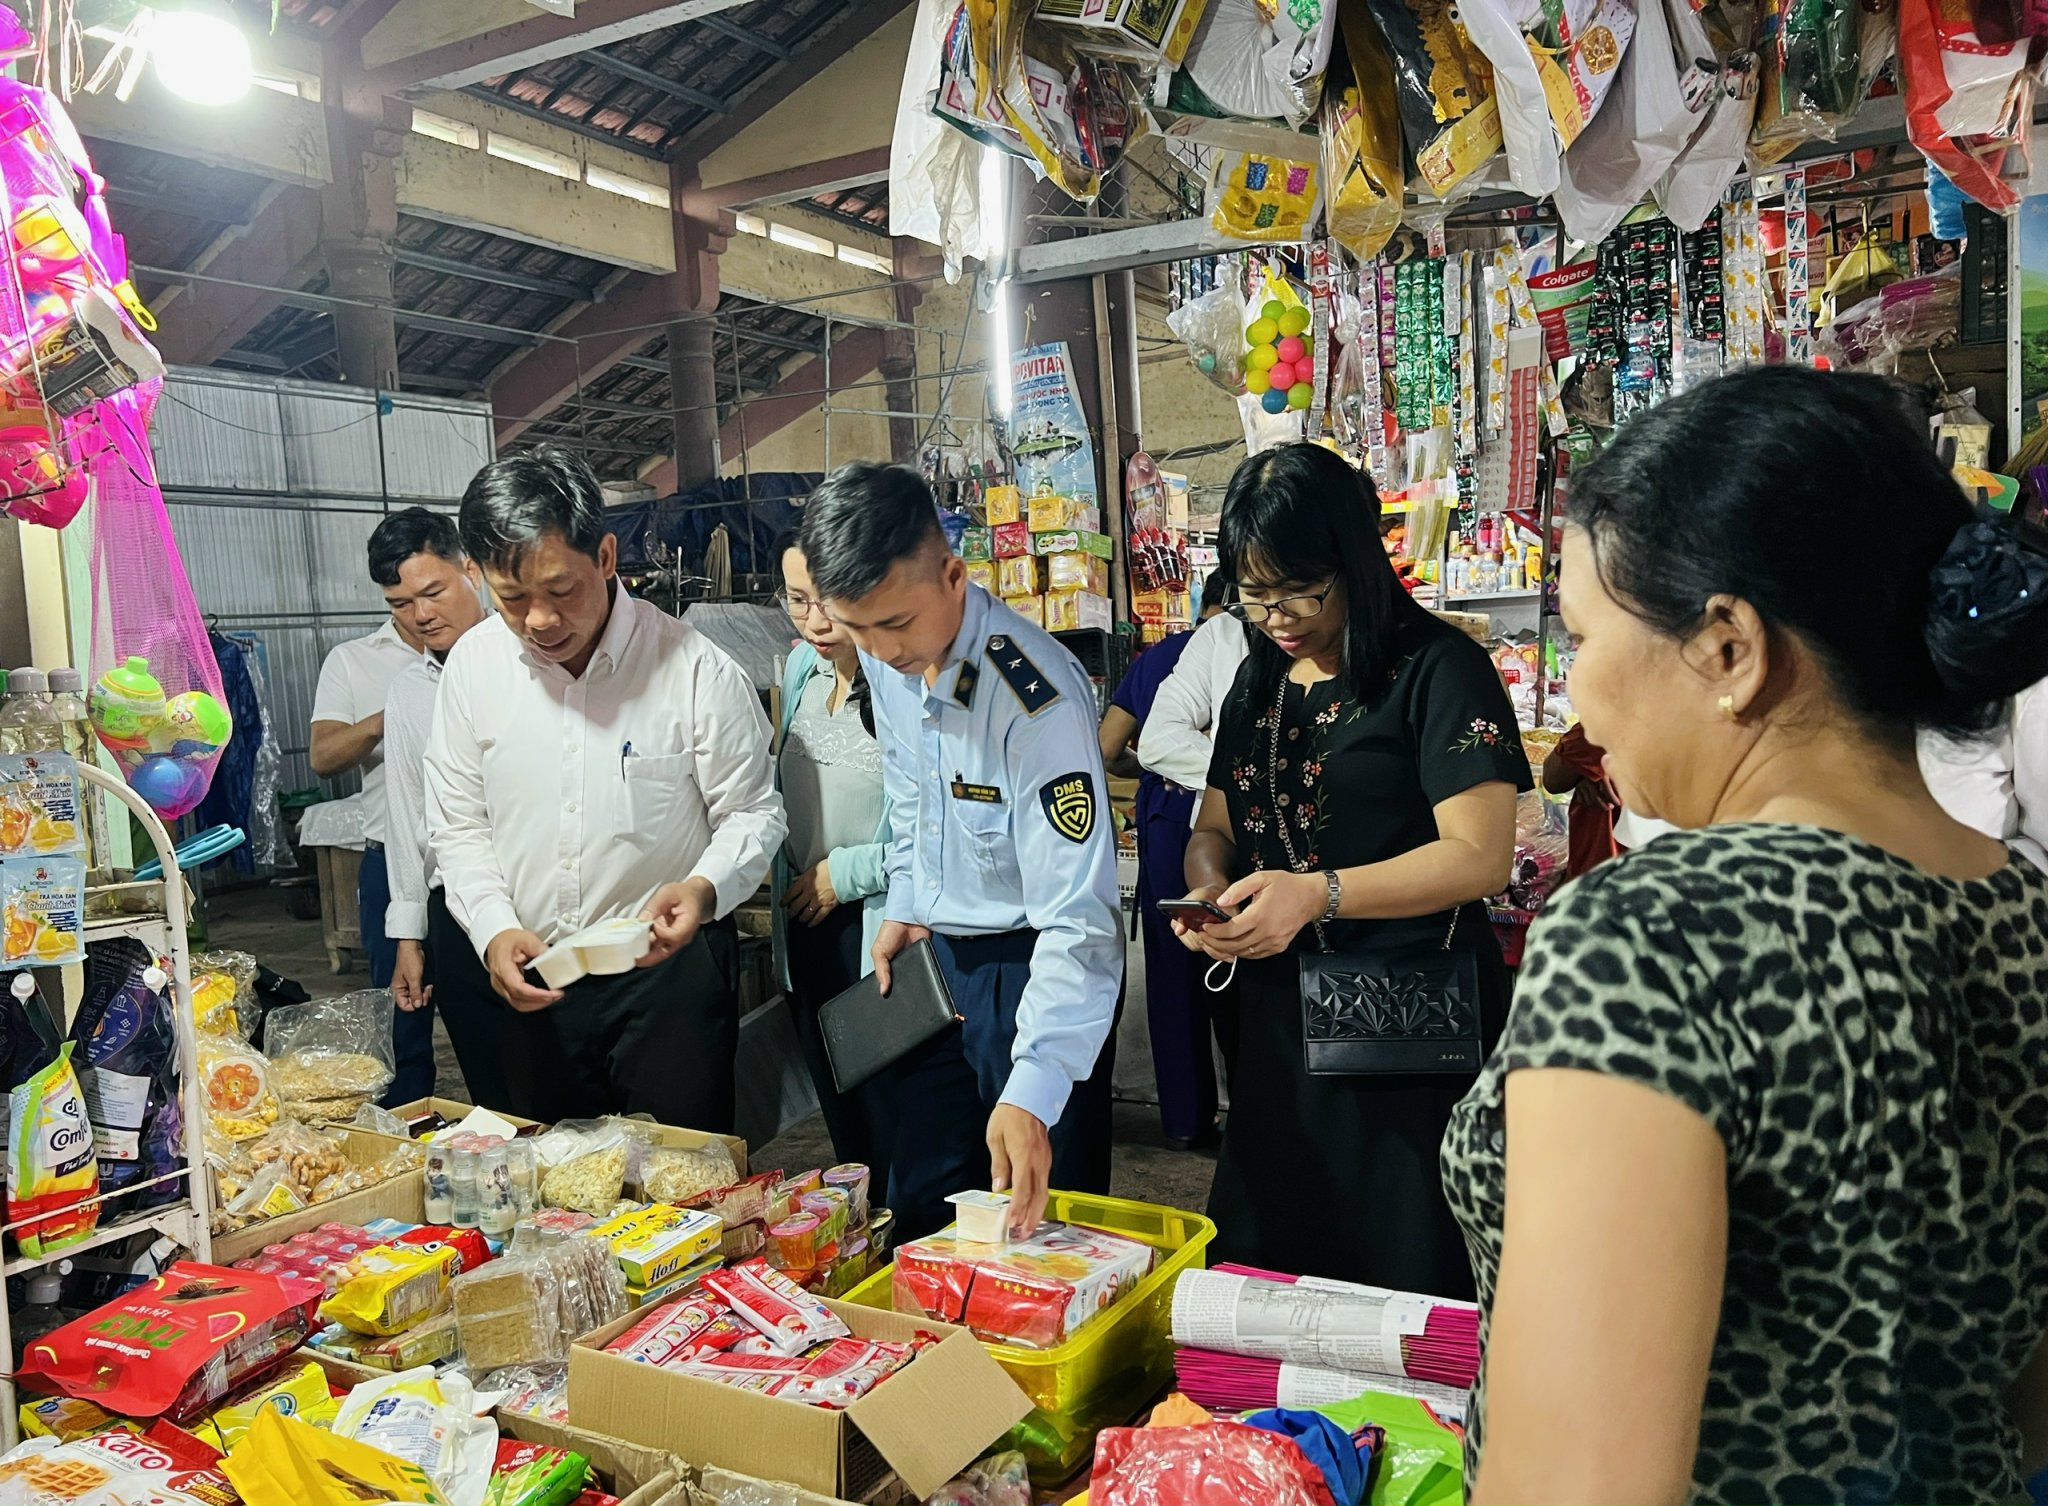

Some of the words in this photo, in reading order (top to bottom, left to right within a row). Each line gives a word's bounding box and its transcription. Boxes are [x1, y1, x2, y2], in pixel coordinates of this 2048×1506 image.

[1542, 269, 1589, 287] Colgate
[1053, 779, 1084, 798] DMS
[82, 1433, 168, 1470] Karo
